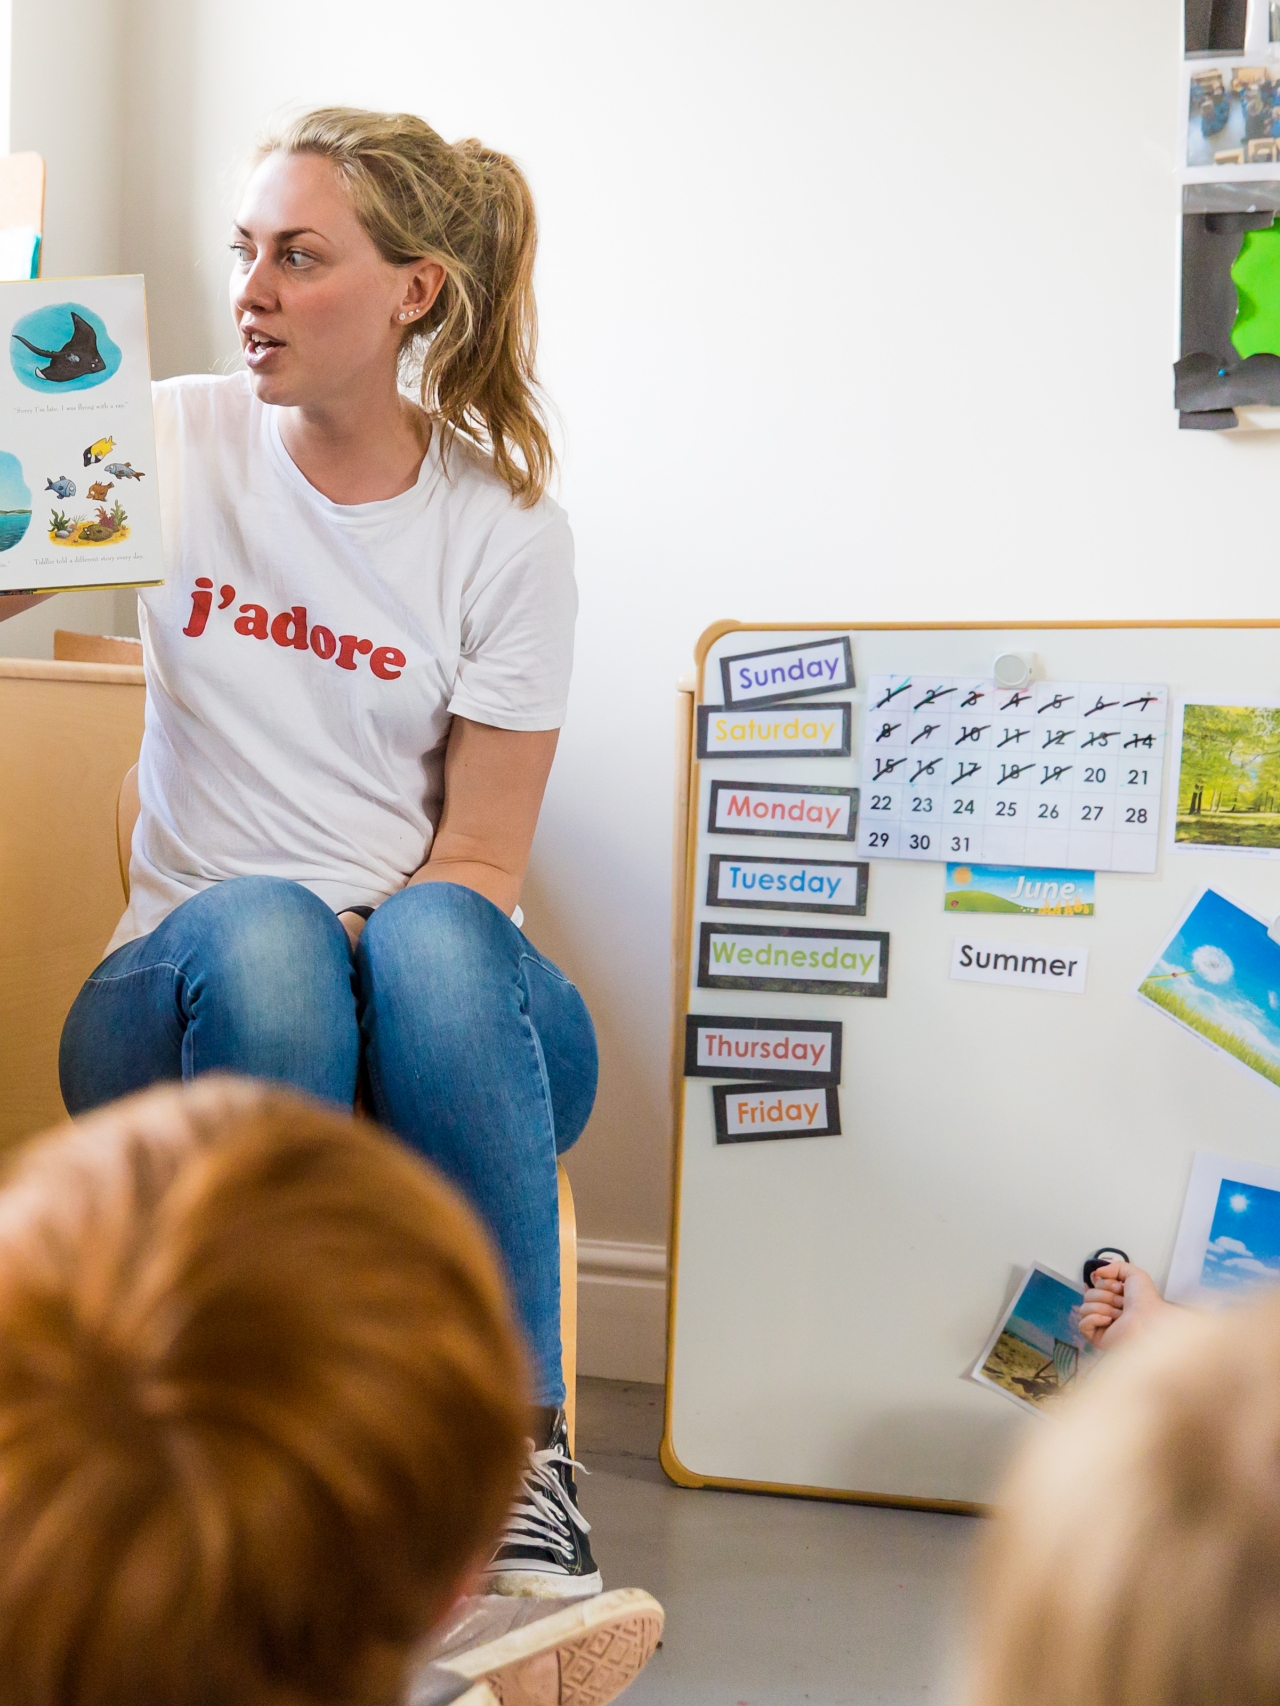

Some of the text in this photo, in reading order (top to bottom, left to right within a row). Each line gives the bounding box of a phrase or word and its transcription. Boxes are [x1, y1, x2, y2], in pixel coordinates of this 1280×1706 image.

[182, 577, 407, 681] j'adore
[739, 657, 840, 690] Sunday
[715, 717, 836, 744] Saturday
[1083, 767, 1106, 784] 20
[1127, 769, 1148, 785] 21
[727, 795, 842, 829] Monday
[870, 795, 1148, 824] 22 23 24 25 26 27 28
[868, 832, 970, 852] 29 30 31
[729, 866, 842, 899] Tuesday
[1009, 875, 1076, 900] June
[712, 941, 875, 976] Wednesday
[959, 944, 1078, 977] Summer
[705, 1034, 826, 1066] Thursday
[737, 1099, 819, 1126] Friday
